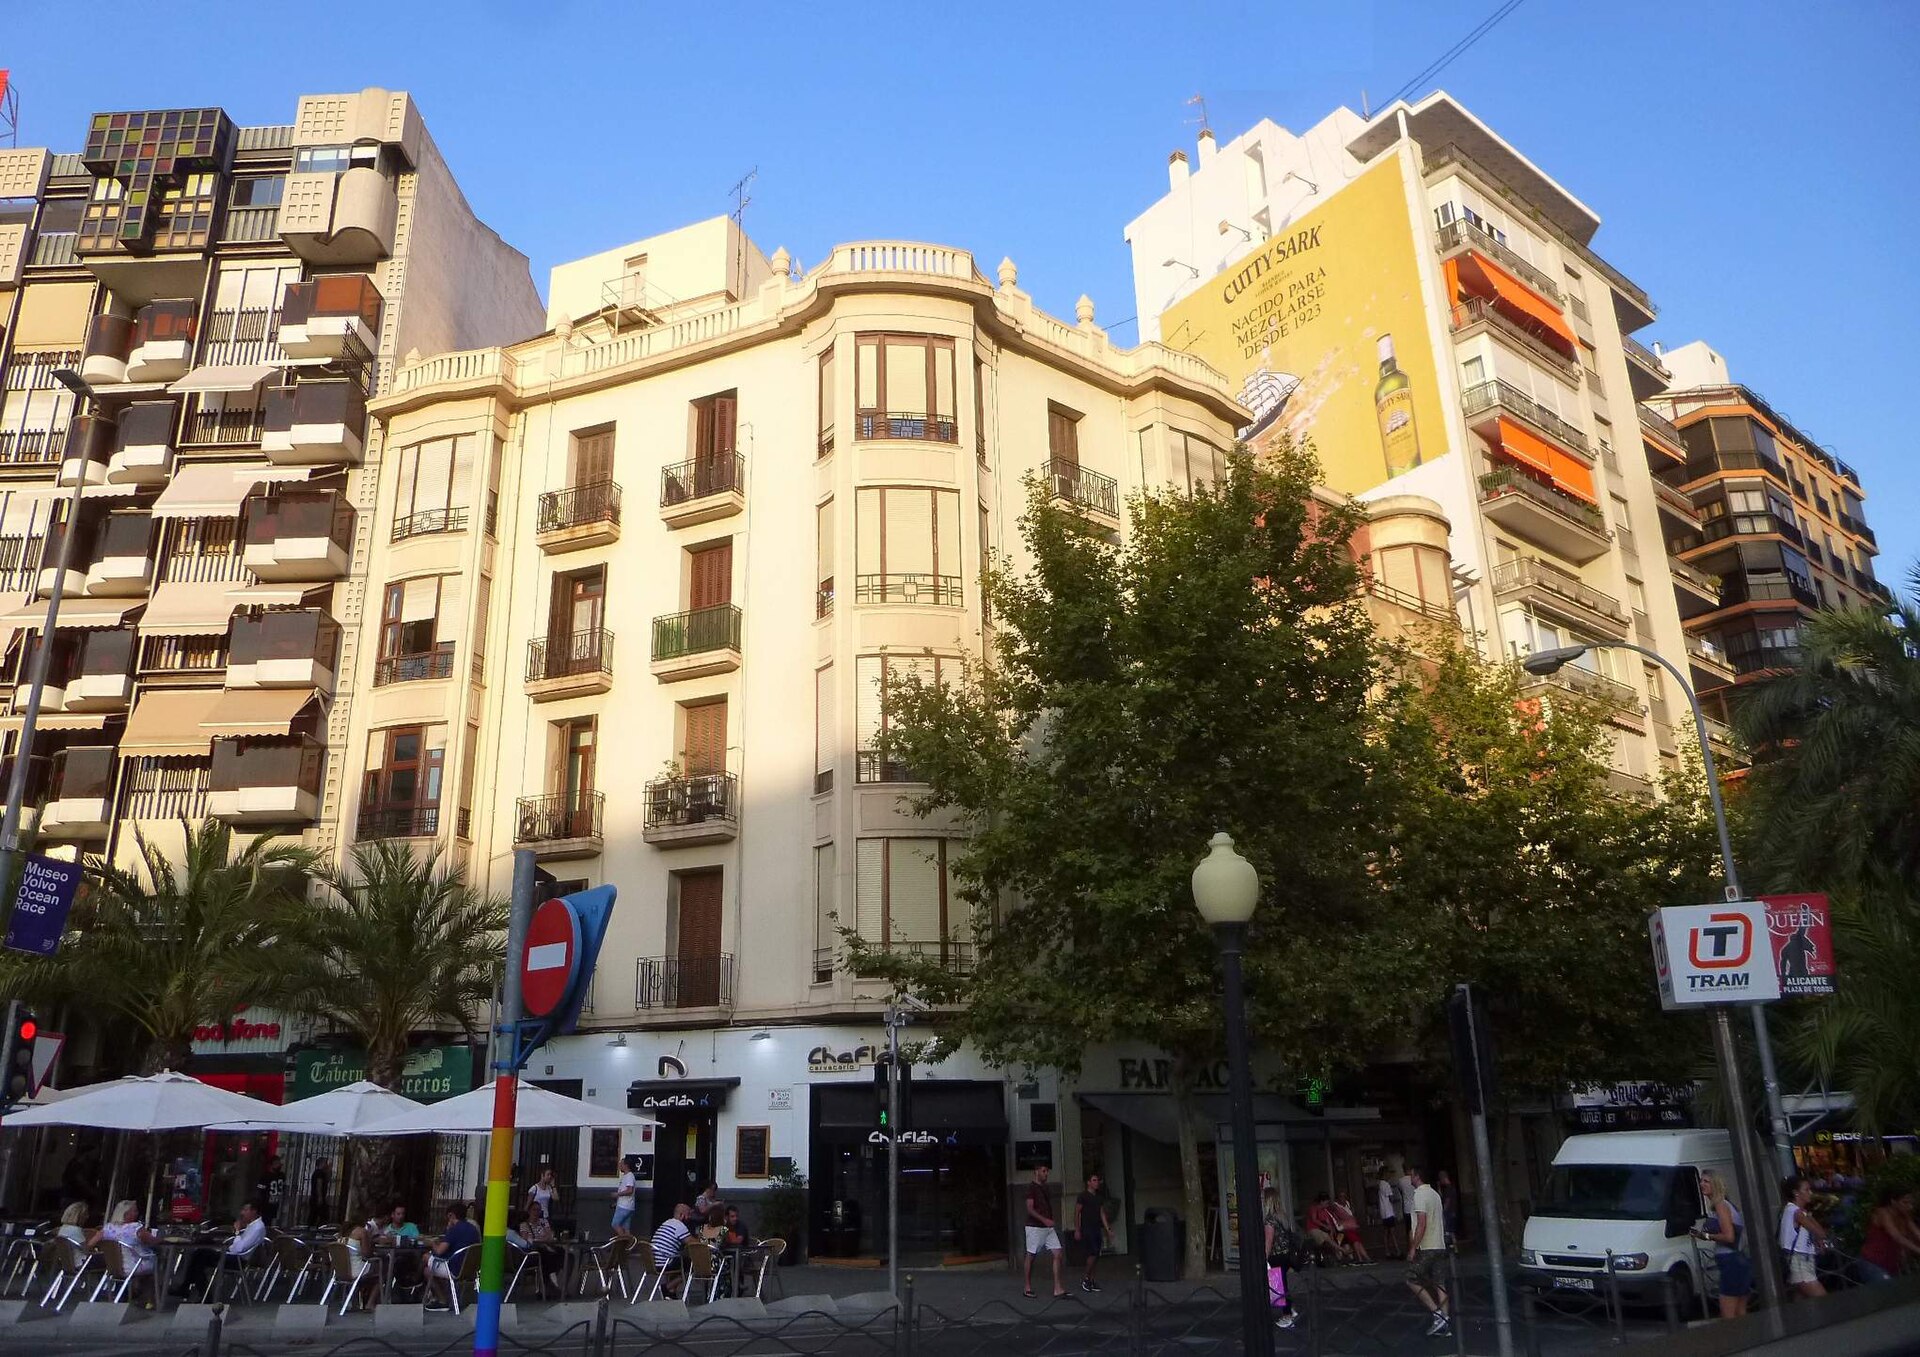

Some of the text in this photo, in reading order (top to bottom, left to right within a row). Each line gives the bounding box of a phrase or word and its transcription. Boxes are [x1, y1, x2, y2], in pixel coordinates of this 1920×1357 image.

[1223, 248, 1273, 304] CUTTY
[1276, 225, 1322, 264] SARK
[1232, 293, 1284, 334] NACIDO
[1288, 266, 1327, 298] PARA
[1237, 283, 1325, 347] MEZCLARSE
[1244, 303, 1321, 360] DESDE 1923
[25, 861, 69, 882] Museo
[22, 873, 57, 892] Volvo
[18, 886, 60, 905] Ocean
[14, 897, 46, 914] Race
[1686, 972, 1750, 989] TRAM
[1783, 985, 1834, 993] PLAZA DE TOROS
[1786, 976, 1828, 986] ALICANTE
[330, 1055, 344, 1065] La
[310, 1061, 365, 1083] Tabern
[868, 1130, 938, 1143] Chflán
